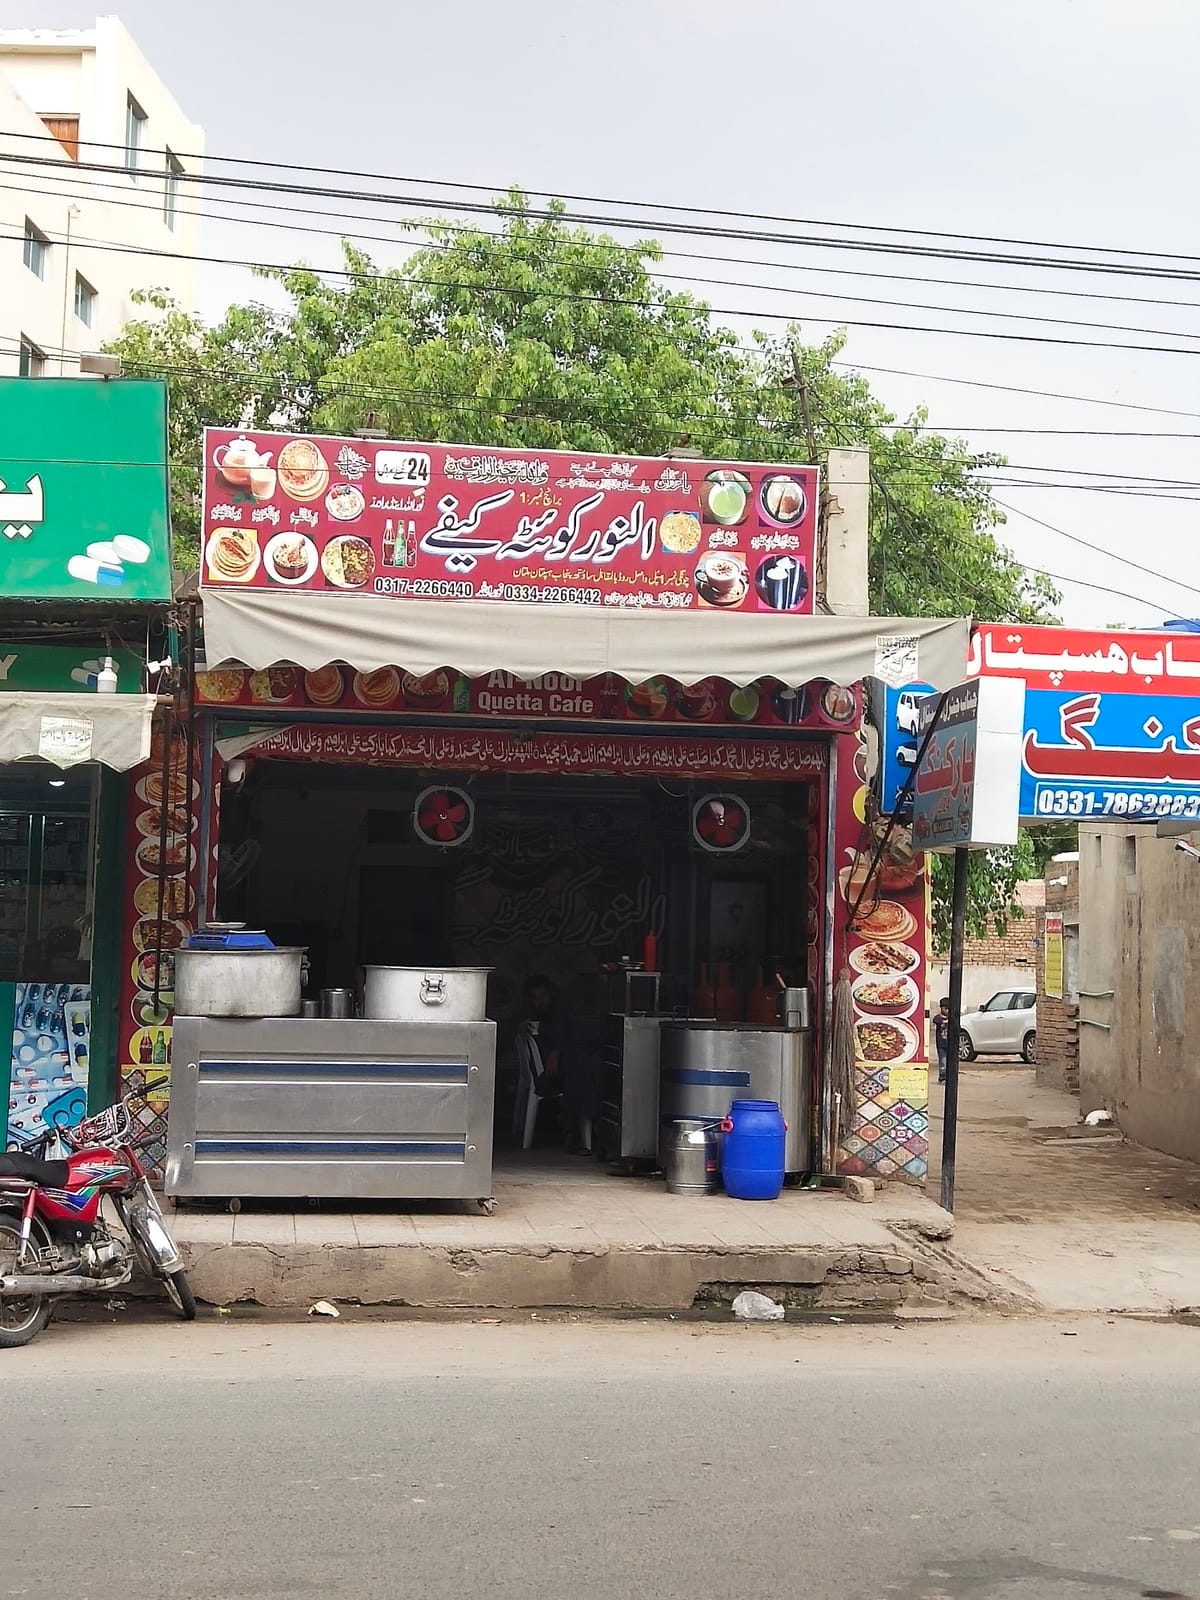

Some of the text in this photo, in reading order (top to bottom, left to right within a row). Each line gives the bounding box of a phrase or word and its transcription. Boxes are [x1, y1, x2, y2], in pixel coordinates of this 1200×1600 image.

[408, 458, 428, 480] 24
[419, 488, 658, 573] النور کوئٹہ کیفے
[374, 577, 474, 598] 0317-2266440
[503, 584, 602, 605] 0334-2266442
[478, 691, 543, 714] Quetta
[549, 695, 594, 714] Cafe
